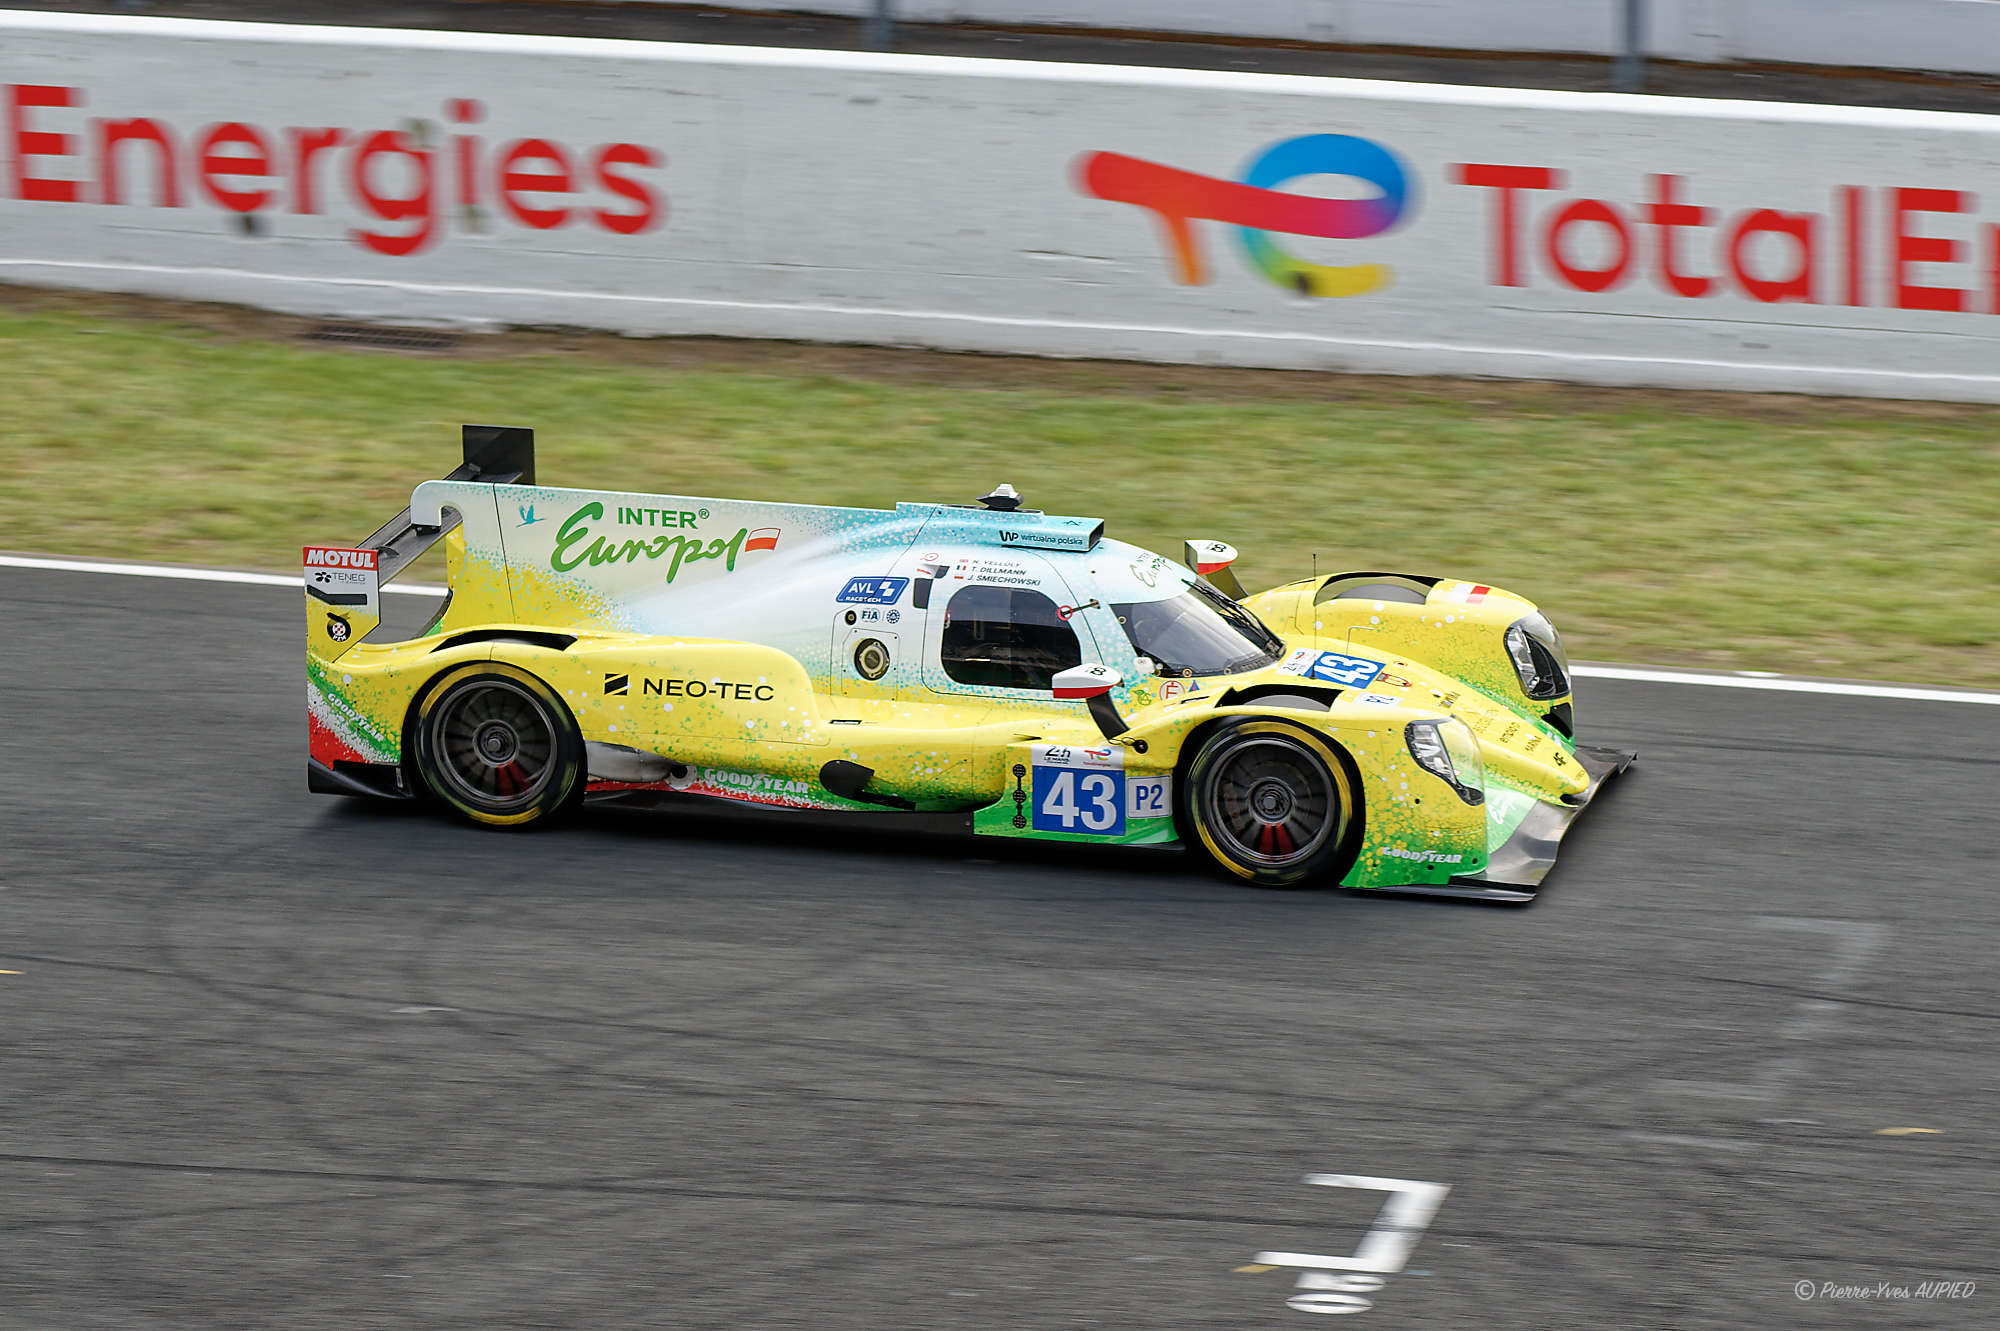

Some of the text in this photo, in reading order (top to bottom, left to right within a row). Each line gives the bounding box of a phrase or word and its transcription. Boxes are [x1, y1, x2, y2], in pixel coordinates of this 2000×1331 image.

[5, 84, 670, 257] Energies
[1447, 160, 2000, 315] TotalE
[550, 501, 747, 584] Europol
[1021, 534, 1056, 543] wirtualna
[1057, 537, 1083, 545] polska
[306, 549, 374, 568] MOTUL
[848, 582, 875, 594] AVL
[1313, 655, 1379, 684] 43
[643, 678, 775, 701] NEO-TEC
[327, 693, 385, 742] GOODYEAR
[703, 768, 809, 794] GOODYEAR
[1042, 771, 1117, 831] 43
[1135, 784, 1164, 811] P2
[1381, 847, 1463, 865] GOODYEAR
